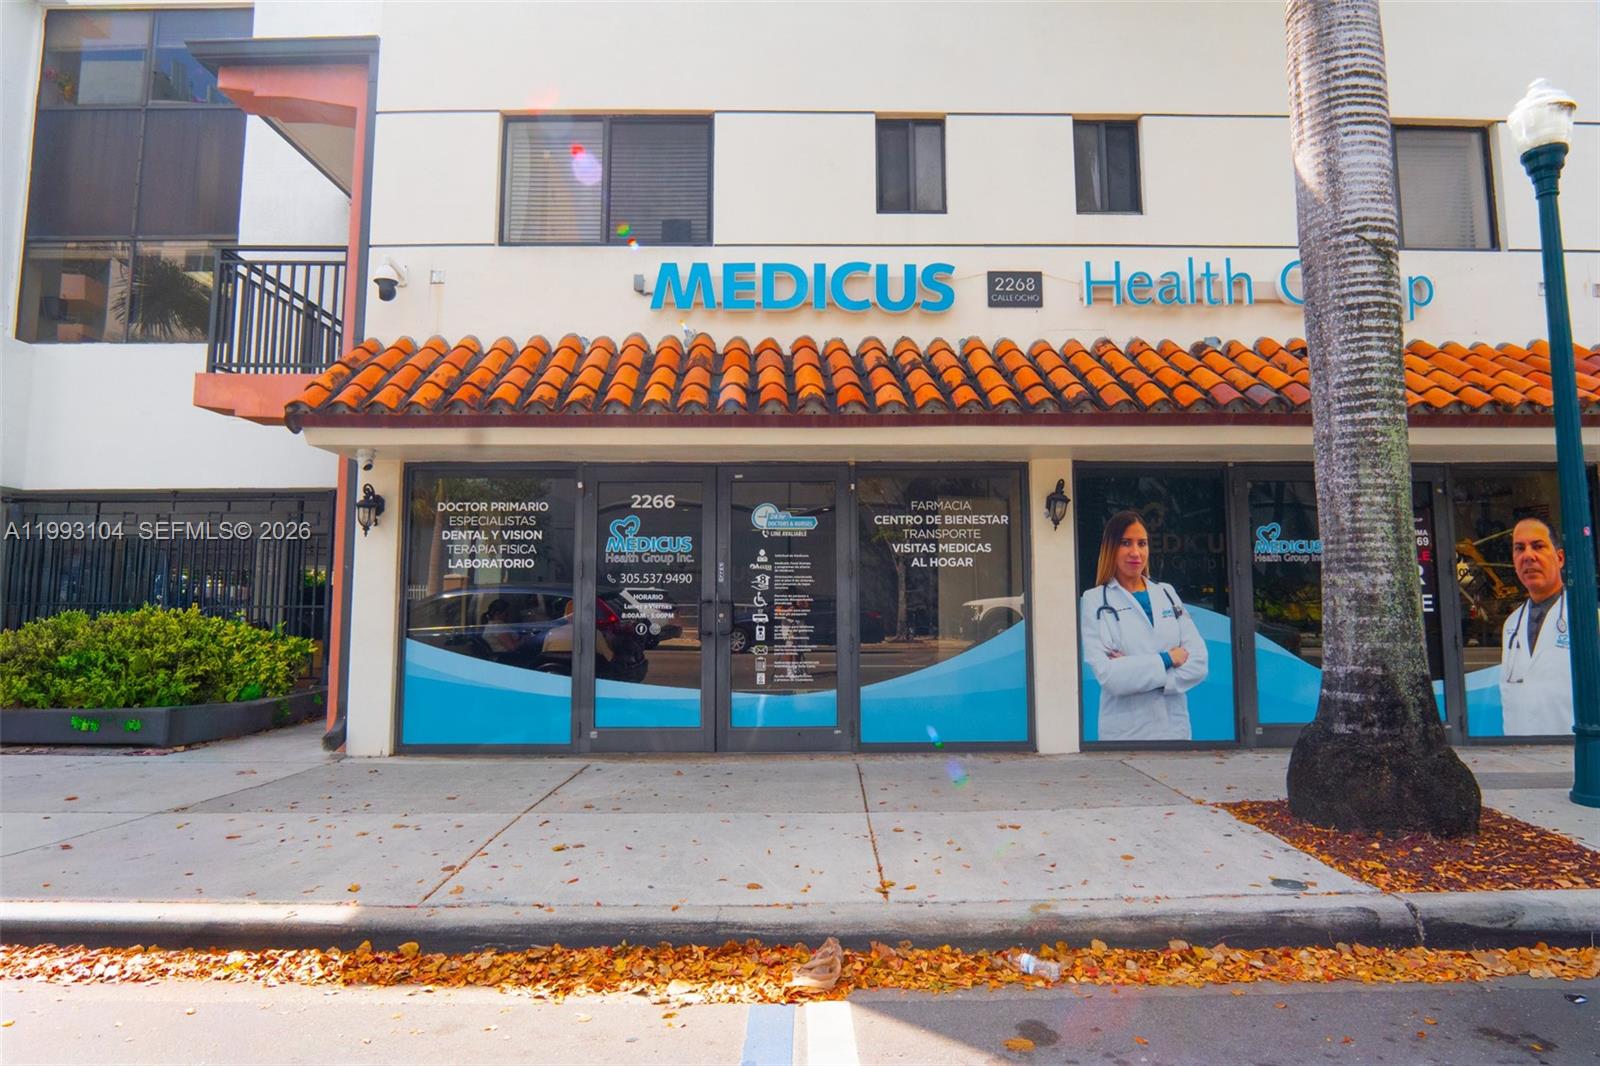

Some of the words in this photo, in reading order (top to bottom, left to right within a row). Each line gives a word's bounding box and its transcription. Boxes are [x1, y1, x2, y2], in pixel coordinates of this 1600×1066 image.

[650, 262, 956, 312] MEDICUS
[994, 277, 1036, 292] 2268
[1083, 257, 1254, 306] Health
[991, 294, 1014, 302] CALLE
[1014, 294, 1040, 302] OCHO
[437, 502, 488, 512] DOCTOR
[490, 502, 549, 512] PRIMARIO
[631, 494, 676, 509] 2266
[911, 501, 971, 511] FARMACIA
[449, 516, 536, 526] ESPECIALISTAS
[874, 515, 923, 525] CENTRO
[925, 515, 942, 525] DE
[945, 515, 1009, 525] BIENESTAR
[442, 530, 488, 541] DENTAL
[491, 530, 500, 541] Y
[502, 530, 543, 541] VISION
[903, 529, 981, 539] TRANSPORTE
[447, 544, 497, 555] TERAPIA
[500, 544, 537, 554] FISICA
[605, 536, 693, 553] MEDICUS
[892, 543, 936, 553] VISITAS
[938, 543, 992, 553] MEDICAS
[1254, 540, 1323, 554] MEDICUS
[448, 558, 535, 569] LABORATORIO
[605, 552, 639, 564] Health
[641, 553, 674, 566] Group
[676, 553, 695, 564] Inc.
[911, 557, 927, 567] AL
[929, 557, 973, 567] HOGAR
[1254, 553, 1282, 562] Health
[1283, 553, 1310, 565] Group
[620, 573, 693, 584] 305.537.9490
